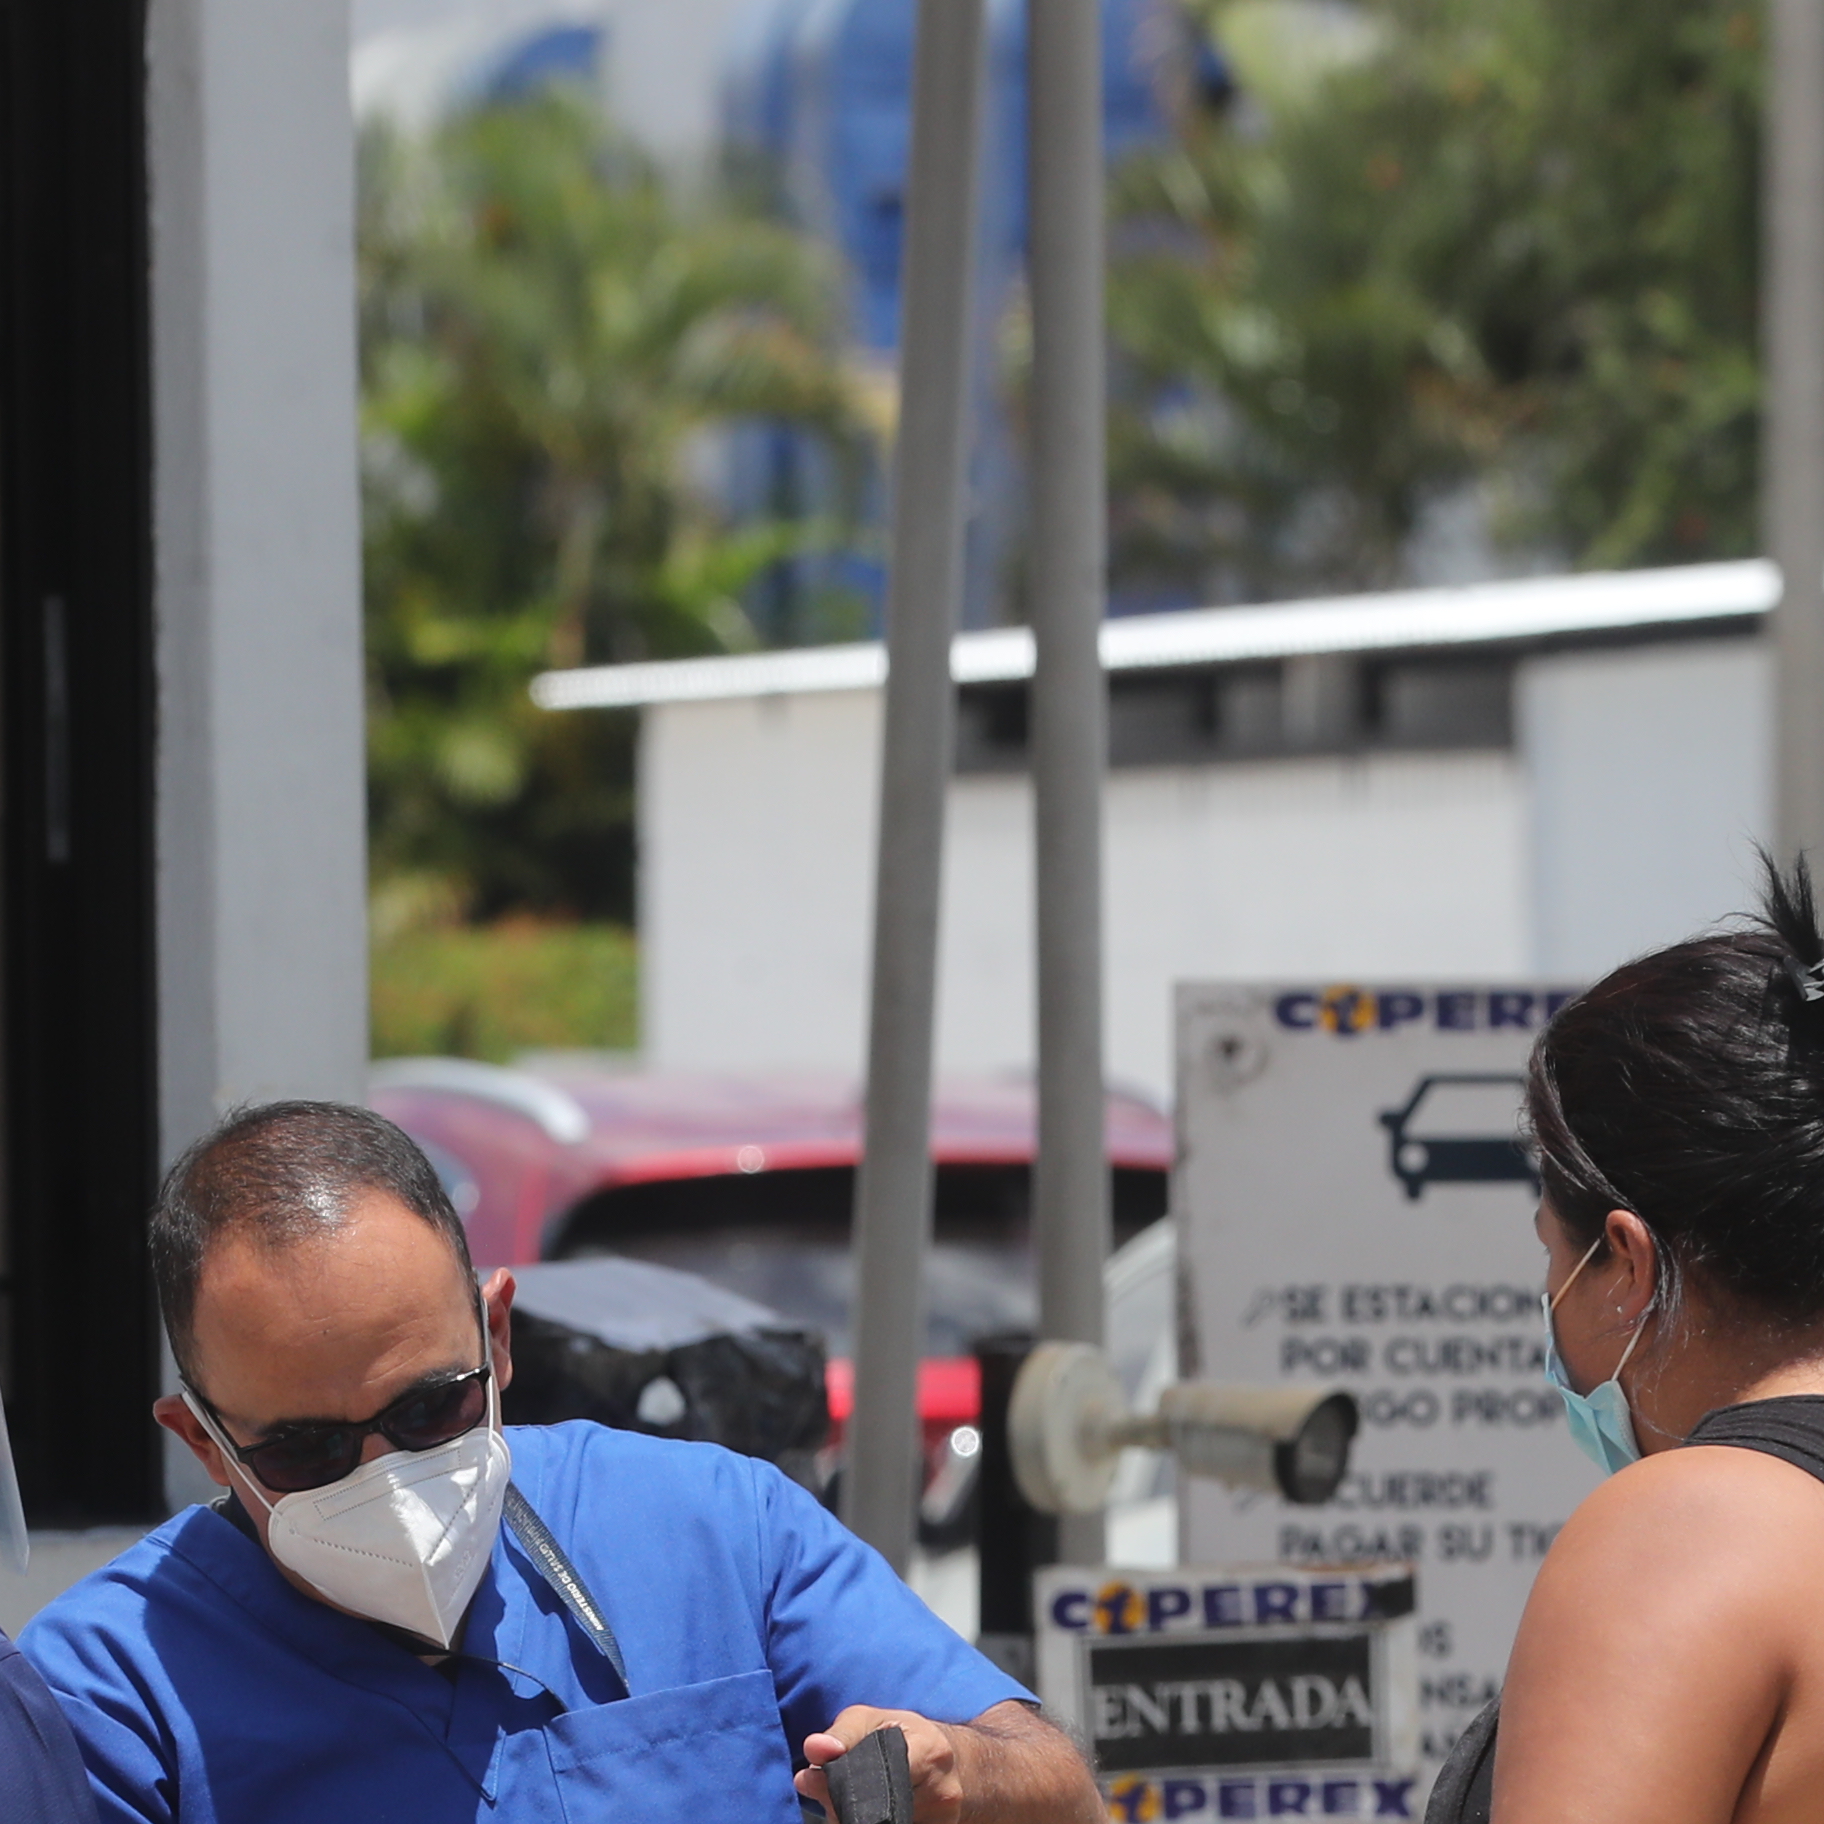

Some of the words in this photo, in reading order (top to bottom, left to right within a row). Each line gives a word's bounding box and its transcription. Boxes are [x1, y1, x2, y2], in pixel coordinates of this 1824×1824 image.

[1284, 1285, 1323, 1324] SE
[1281, 1336, 1370, 1376] POR
[1438, 1522, 1494, 1563] SU
[1097, 1672, 1373, 1741] ENTRADA
